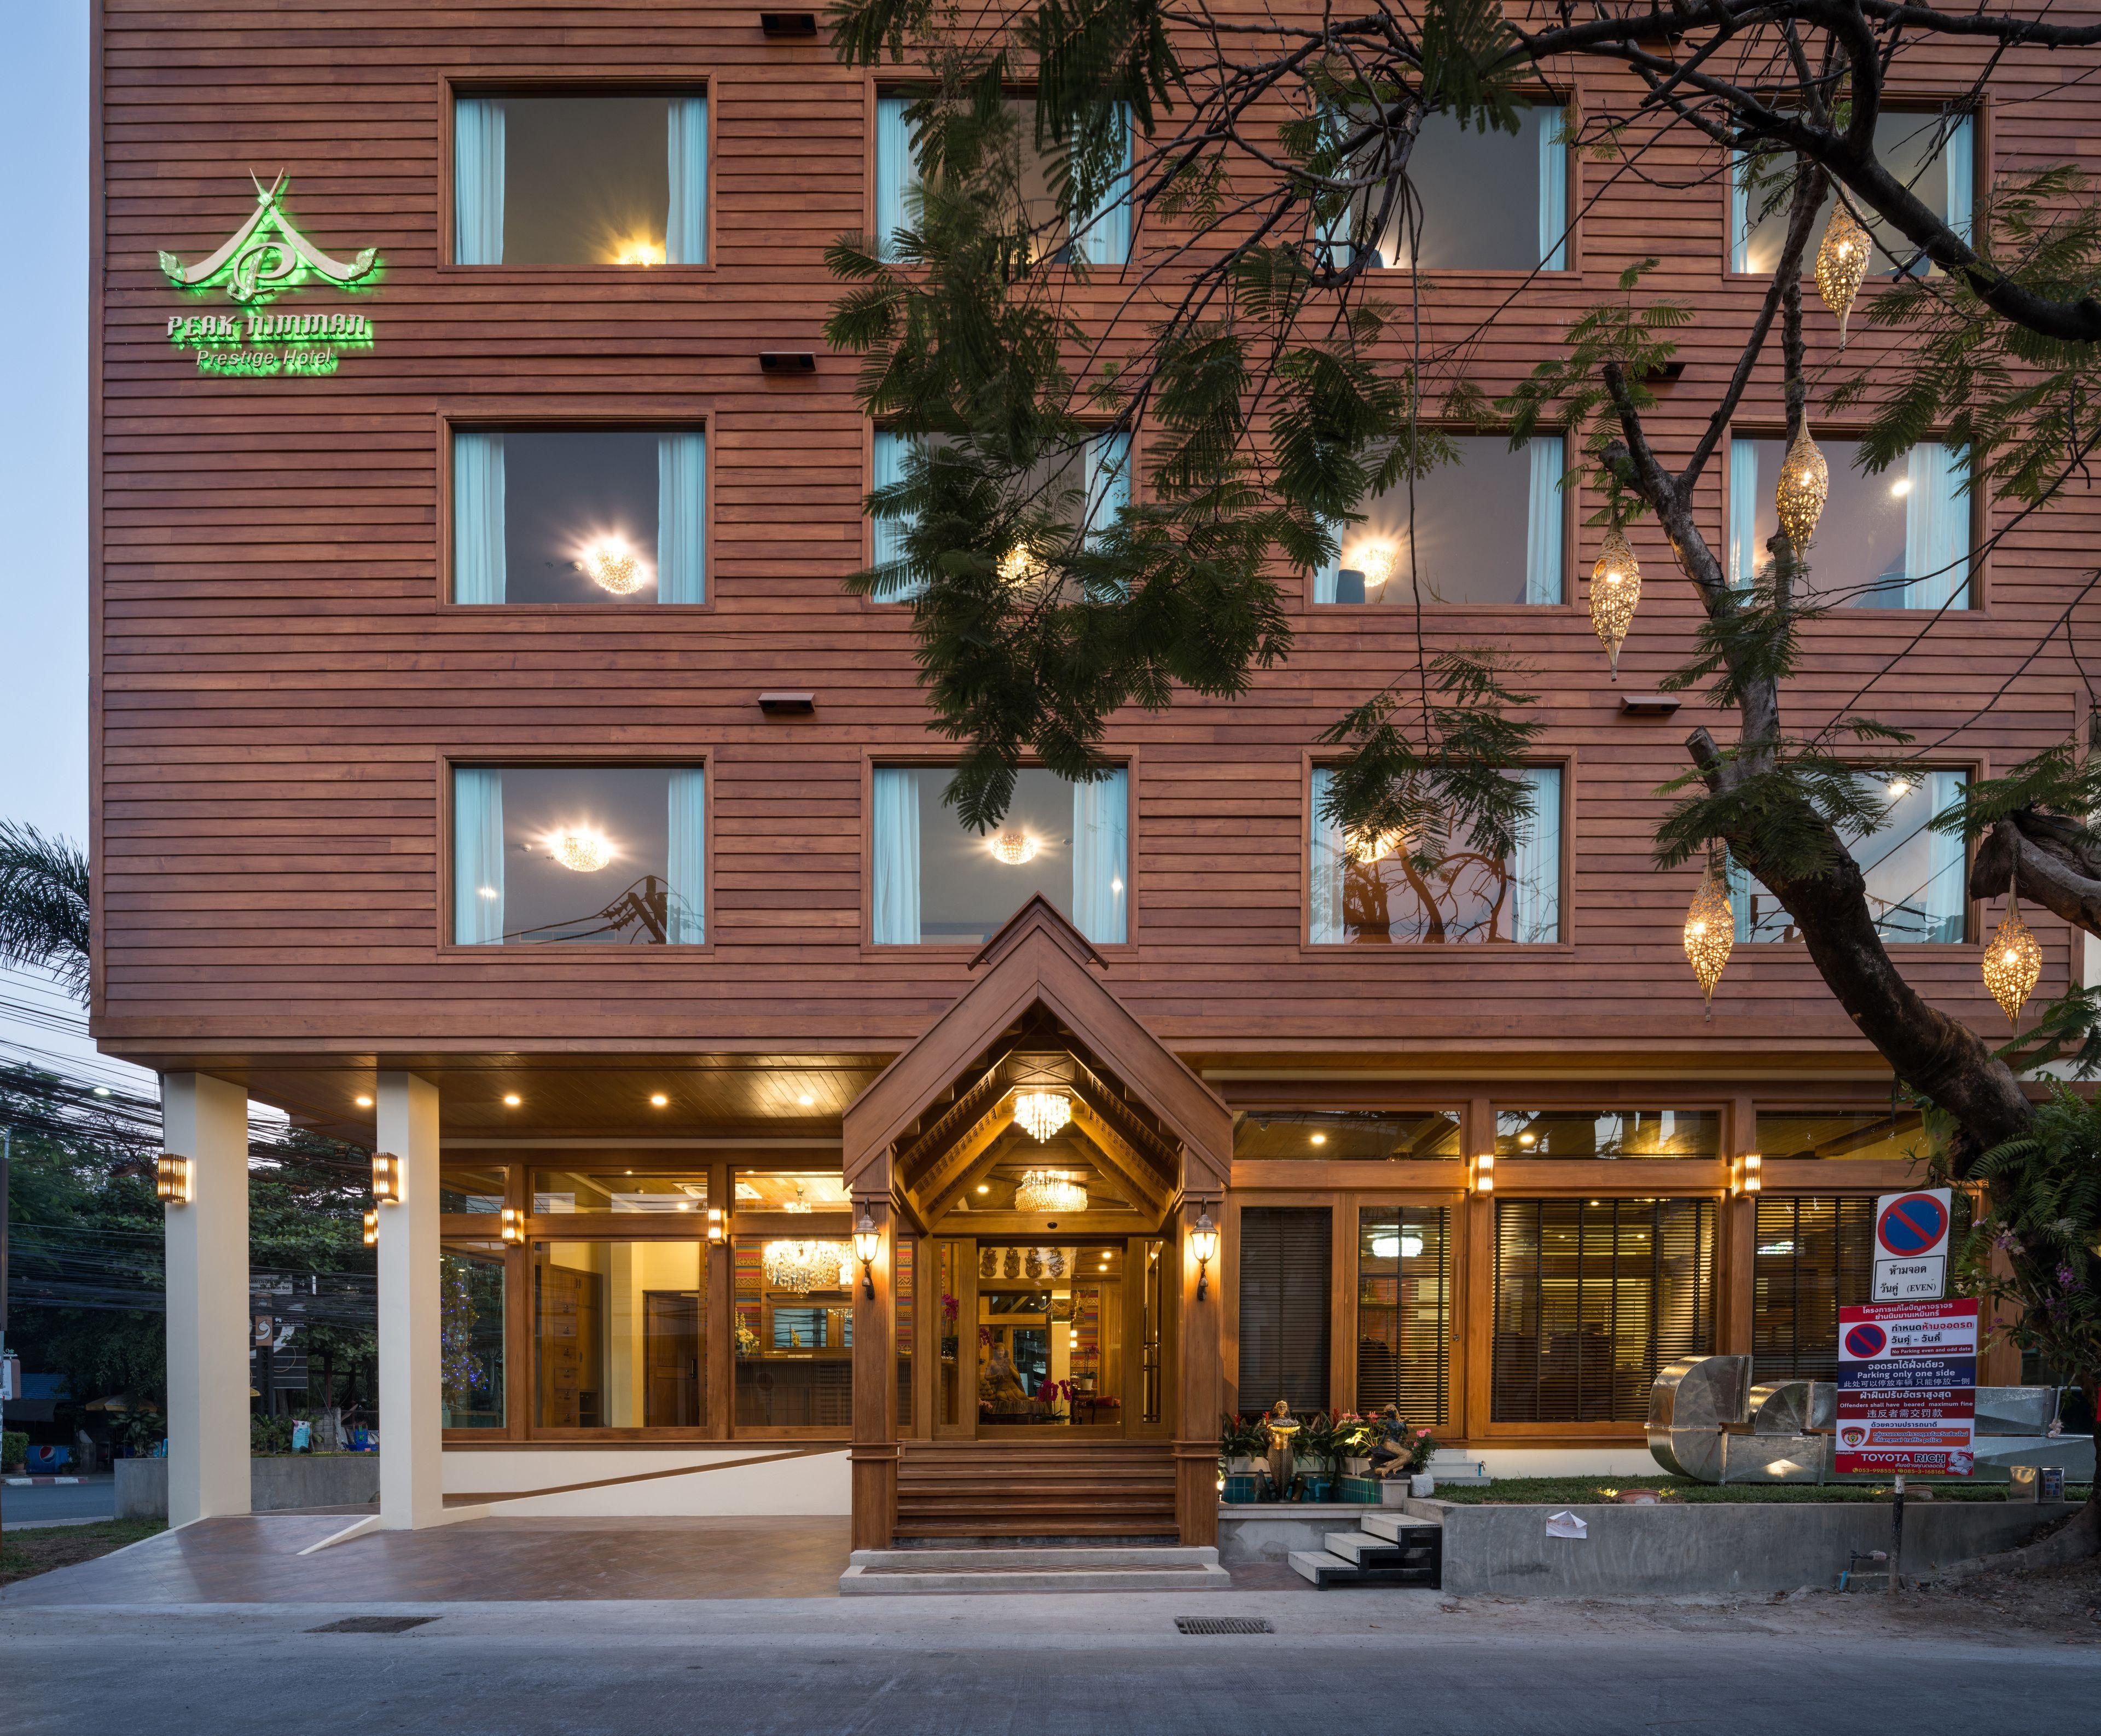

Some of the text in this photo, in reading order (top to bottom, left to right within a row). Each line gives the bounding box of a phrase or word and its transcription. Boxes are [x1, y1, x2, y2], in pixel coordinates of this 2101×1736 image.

[166, 313, 367, 338] PEAK NIMMAN
[196, 347, 332, 368] Prestige Hotel
[1889, 1264, 1927, 1275] ห้ามจอด
[1880, 1282, 1936, 1296] วันคู่ (EVEN)
[1875, 1310, 1940, 1320] ย่านนิมมานเหมินทร์
[1891, 1335, 1911, 1345] วันคู่
[1922, 1332, 1941, 1343] วันคี่
[1868, 1360, 1945, 1370] จอดรถได้ฝั่งเดียว
[1844, 1378, 1970, 1387] 此处可以停放车辆 只能停放一侧
[1860, 1390, 1952, 1400] ฝ่าฝืนปรับอัตราสูงสุด
[1867, 1409, 1943, 1418] 违反者需交罚款
[1861, 1454, 1946, 1463] TOYOTA RICH
